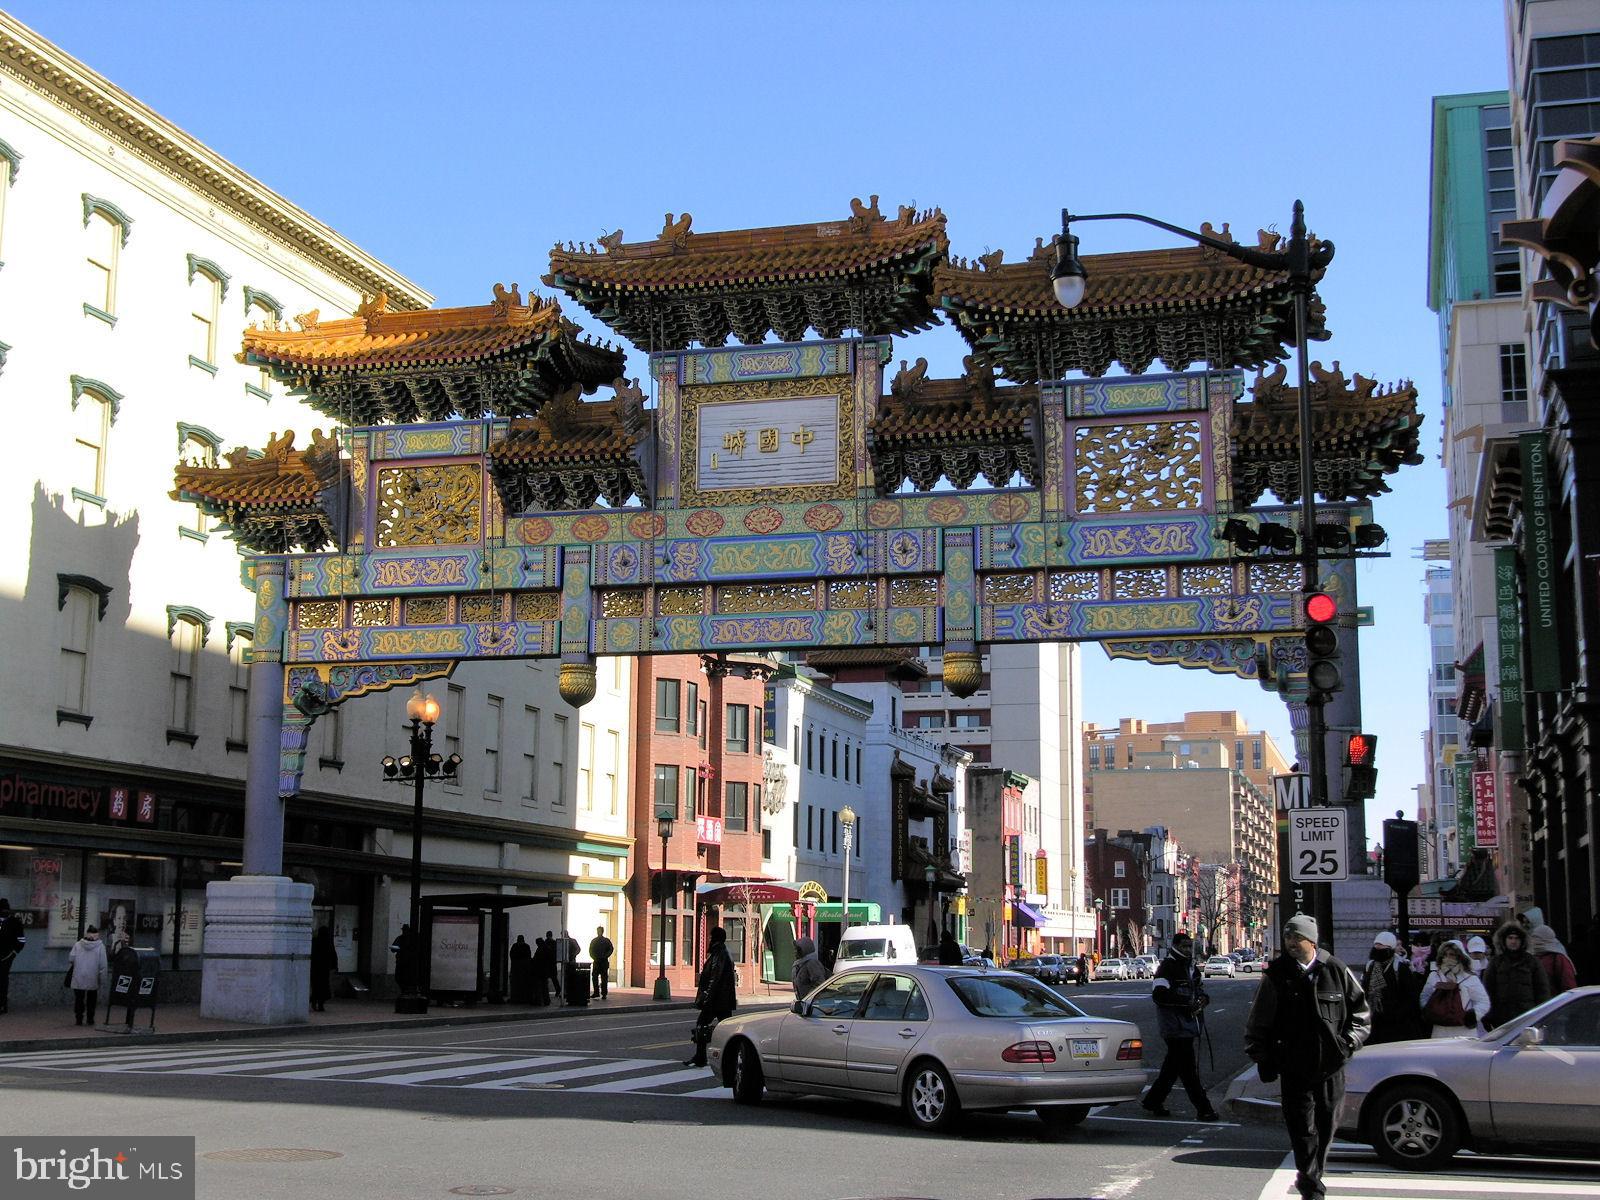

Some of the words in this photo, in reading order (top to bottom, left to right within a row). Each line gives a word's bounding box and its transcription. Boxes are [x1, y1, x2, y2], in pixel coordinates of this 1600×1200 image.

[1534, 510, 1545, 526] OF
[1535, 530, 1549, 578] COLORS
[1539, 582, 1552, 628] UNITED
[0, 773, 100, 816] pharmacy
[1295, 817, 1340, 829] SPEED
[1301, 830, 1335, 841] LIMIT
[33, 858, 60, 873] OPEN
[1299, 849, 1339, 875] 25
[1408, 918, 1441, 926] CHINESE
[1444, 917, 1494, 926] RESTAURANT
